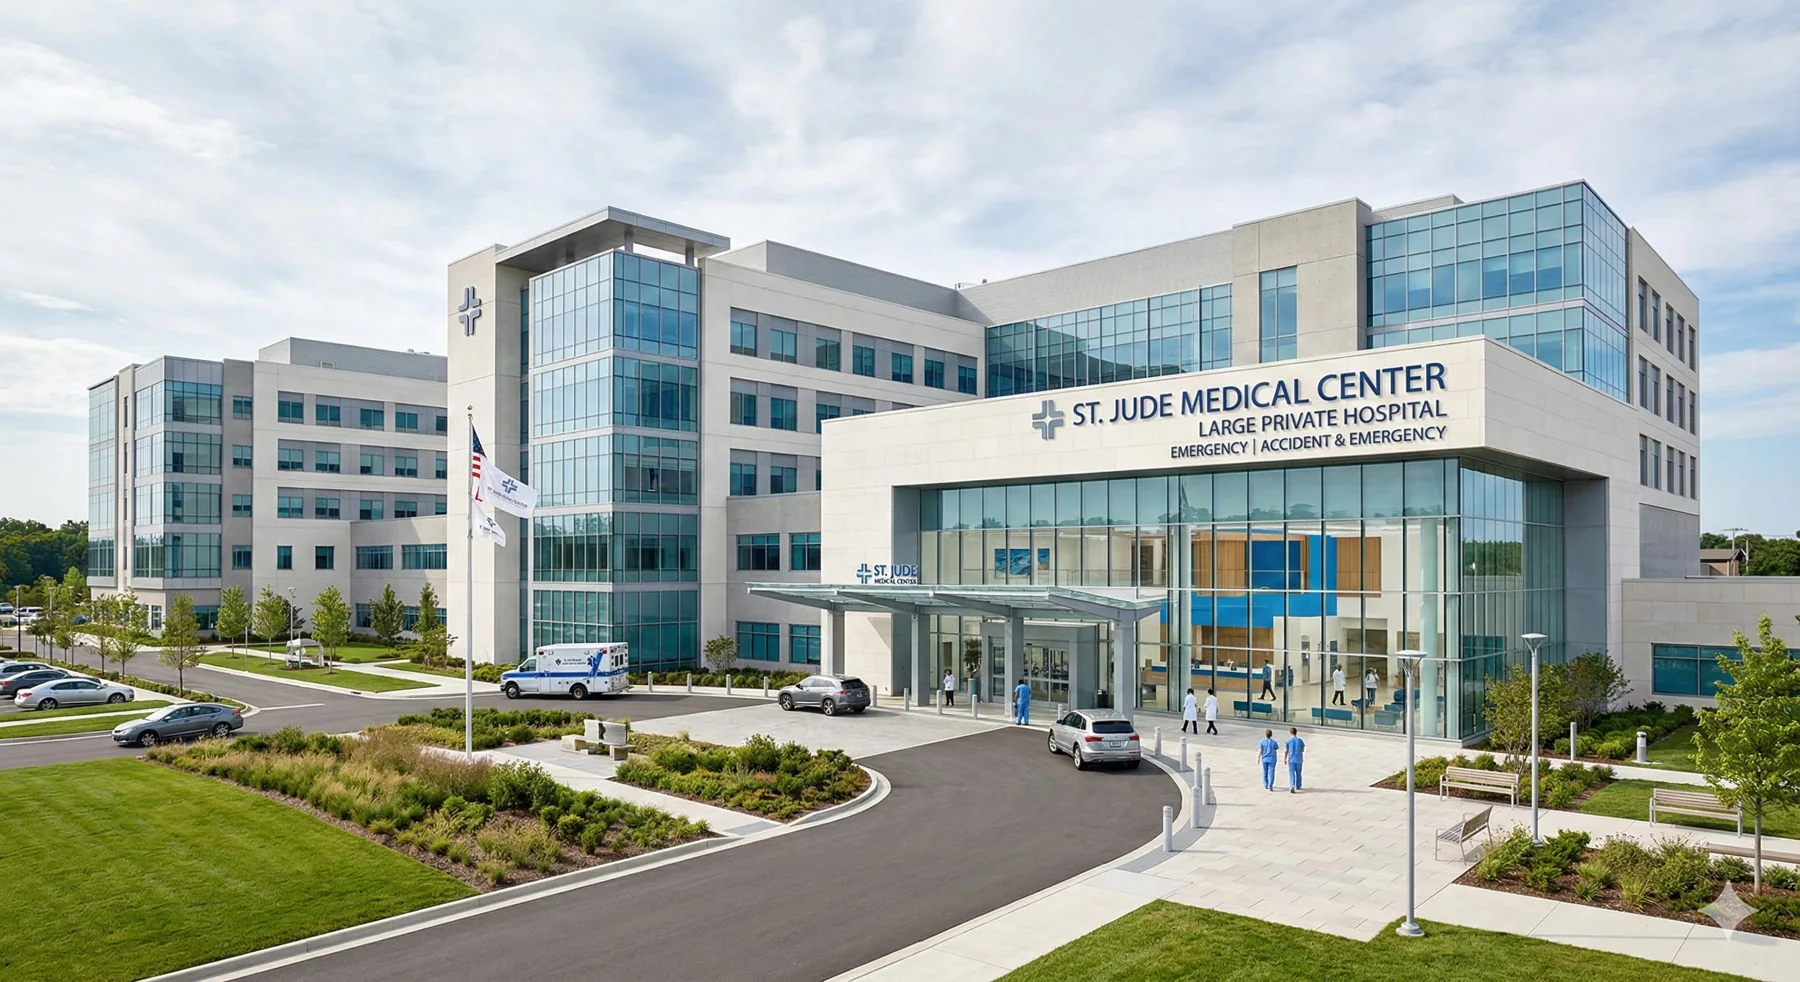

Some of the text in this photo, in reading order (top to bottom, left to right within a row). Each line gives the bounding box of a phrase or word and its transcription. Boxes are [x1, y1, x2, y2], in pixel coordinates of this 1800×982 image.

[1073, 362, 1446, 426] ST. JUDE MEDICAL CENTER
[1199, 400, 1447, 437] LARGE PRIVATE HOSPITAL
[1171, 441, 1248, 458] EMERGENCY
[1261, 434, 1331, 452] ACCIDENT
[1335, 433, 1345, 446] &
[1350, 425, 1447, 445] EMERGENCY
[874, 564, 917, 579] ST. JUDE
